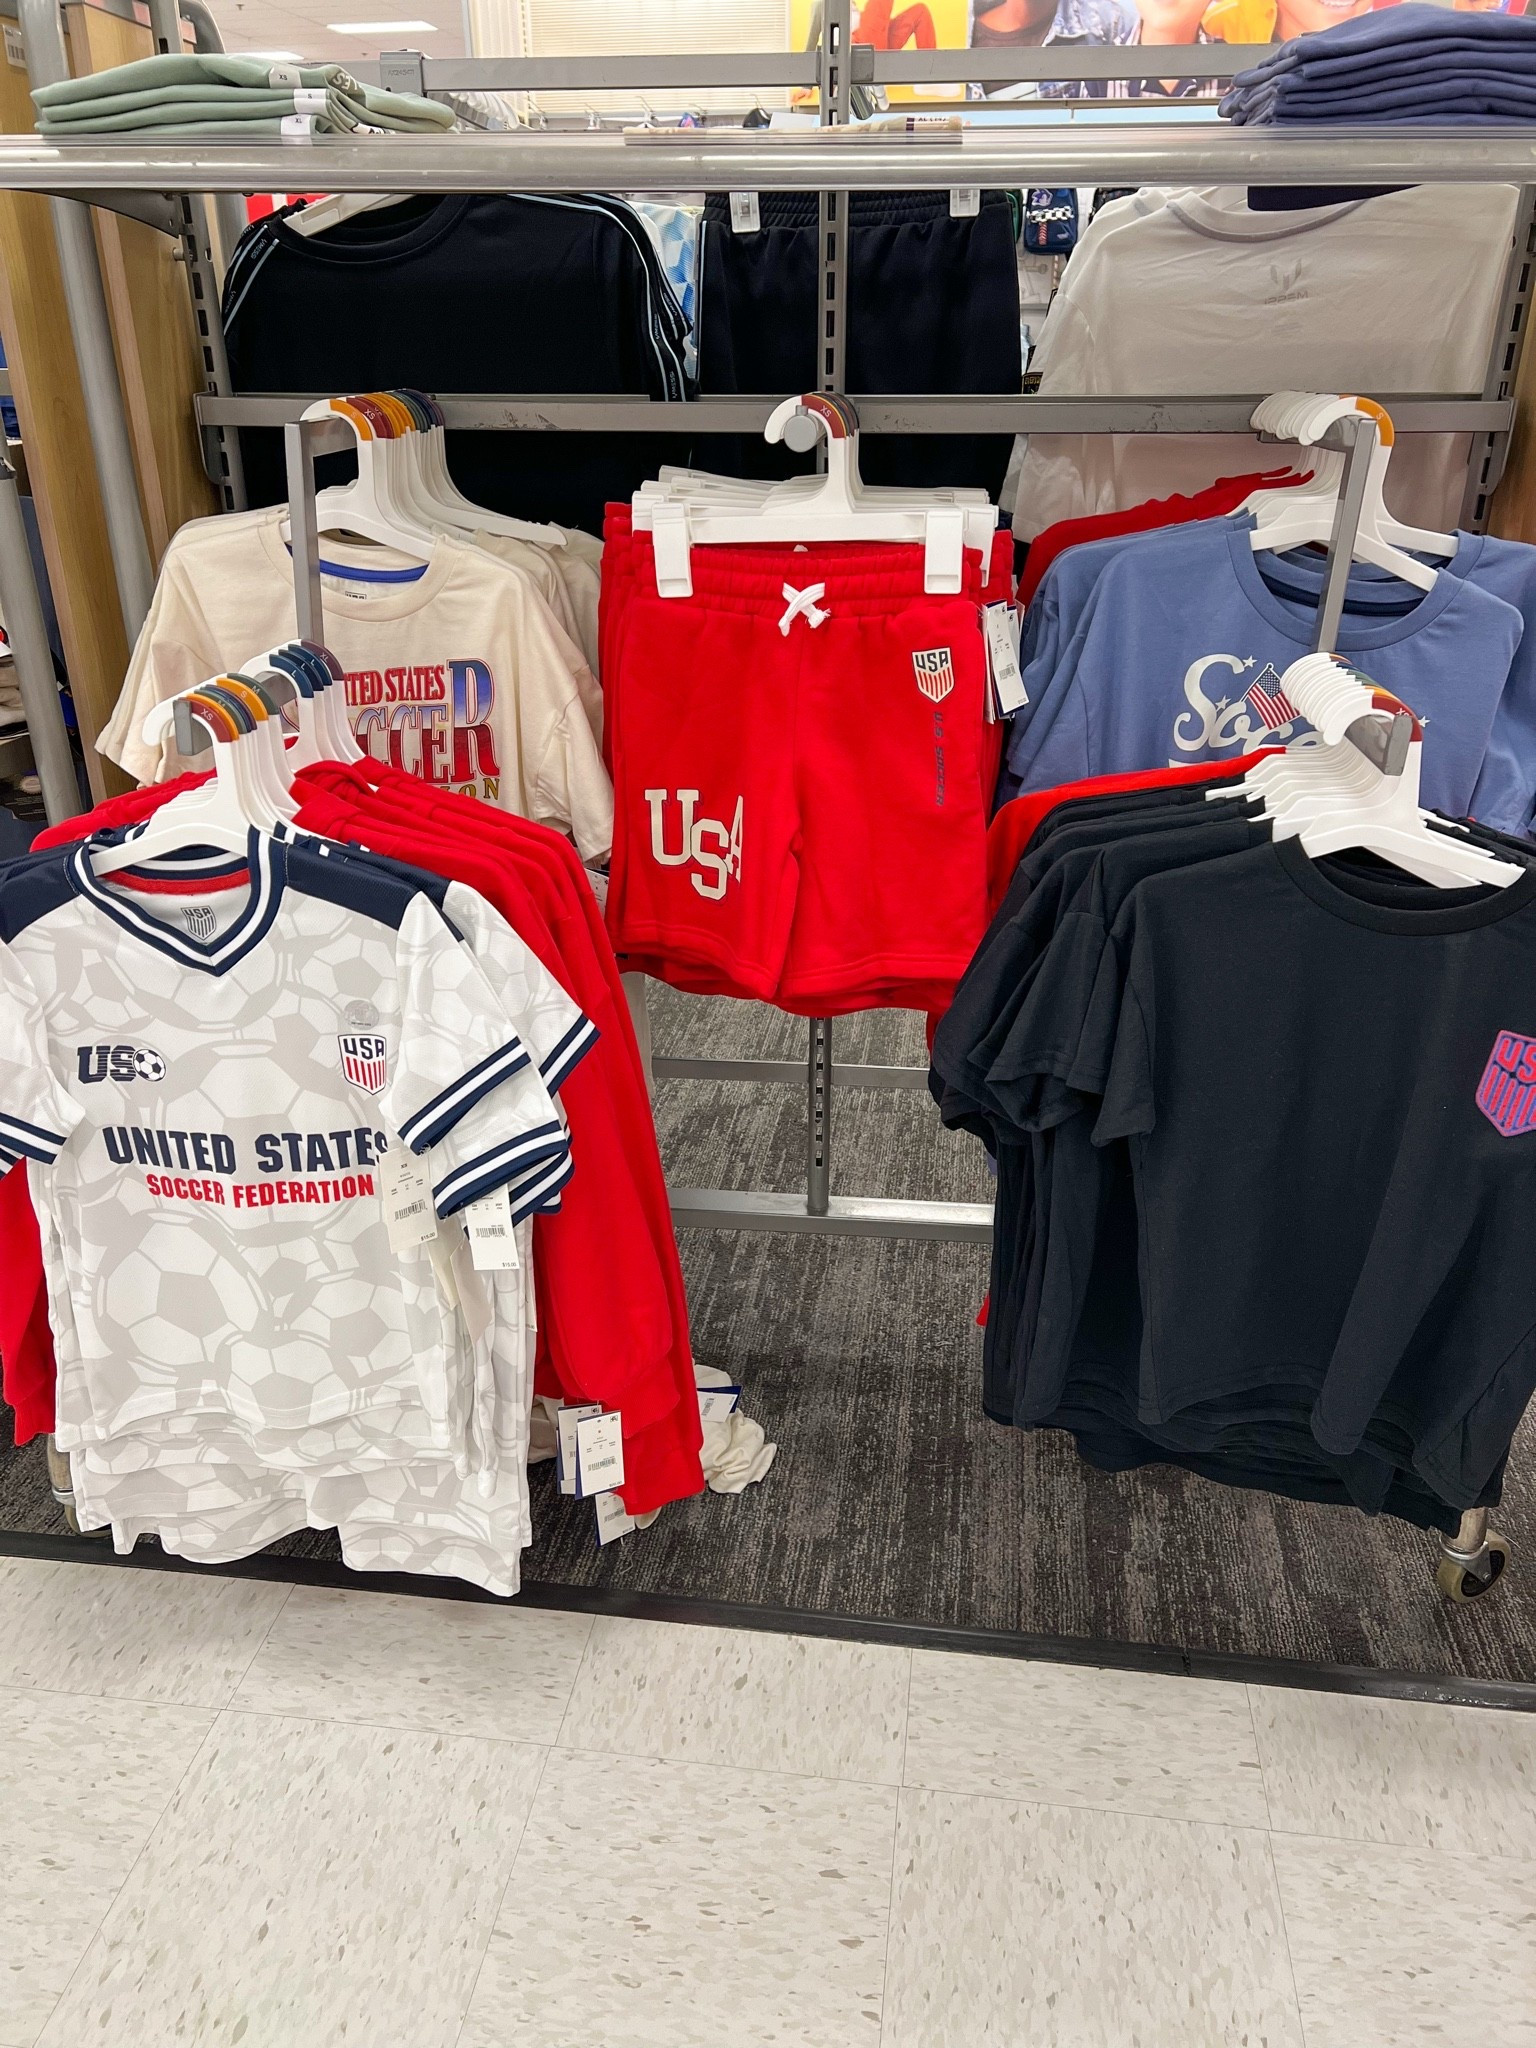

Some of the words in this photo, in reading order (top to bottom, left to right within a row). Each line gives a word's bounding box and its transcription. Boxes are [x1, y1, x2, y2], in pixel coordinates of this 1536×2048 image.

[364, 408, 376, 420] XS
[820, 405, 831, 417] XS
[320, 652, 329, 662] XL
[915, 651, 949, 672] USA
[241, 690, 248, 698] S
[384, 664, 446, 703] STATES
[201, 708, 213, 720] XS
[325, 658, 500, 784] CCER
[645, 789, 744, 901] USA
[184, 908, 211, 918] USA
[343, 1038, 385, 1060] USA
[102, 1126, 236, 1175] UNITED
[255, 1127, 388, 1173] STATES
[146, 1173, 225, 1205] SOCCER
[233, 1174, 375, 1208] FEDERATION
